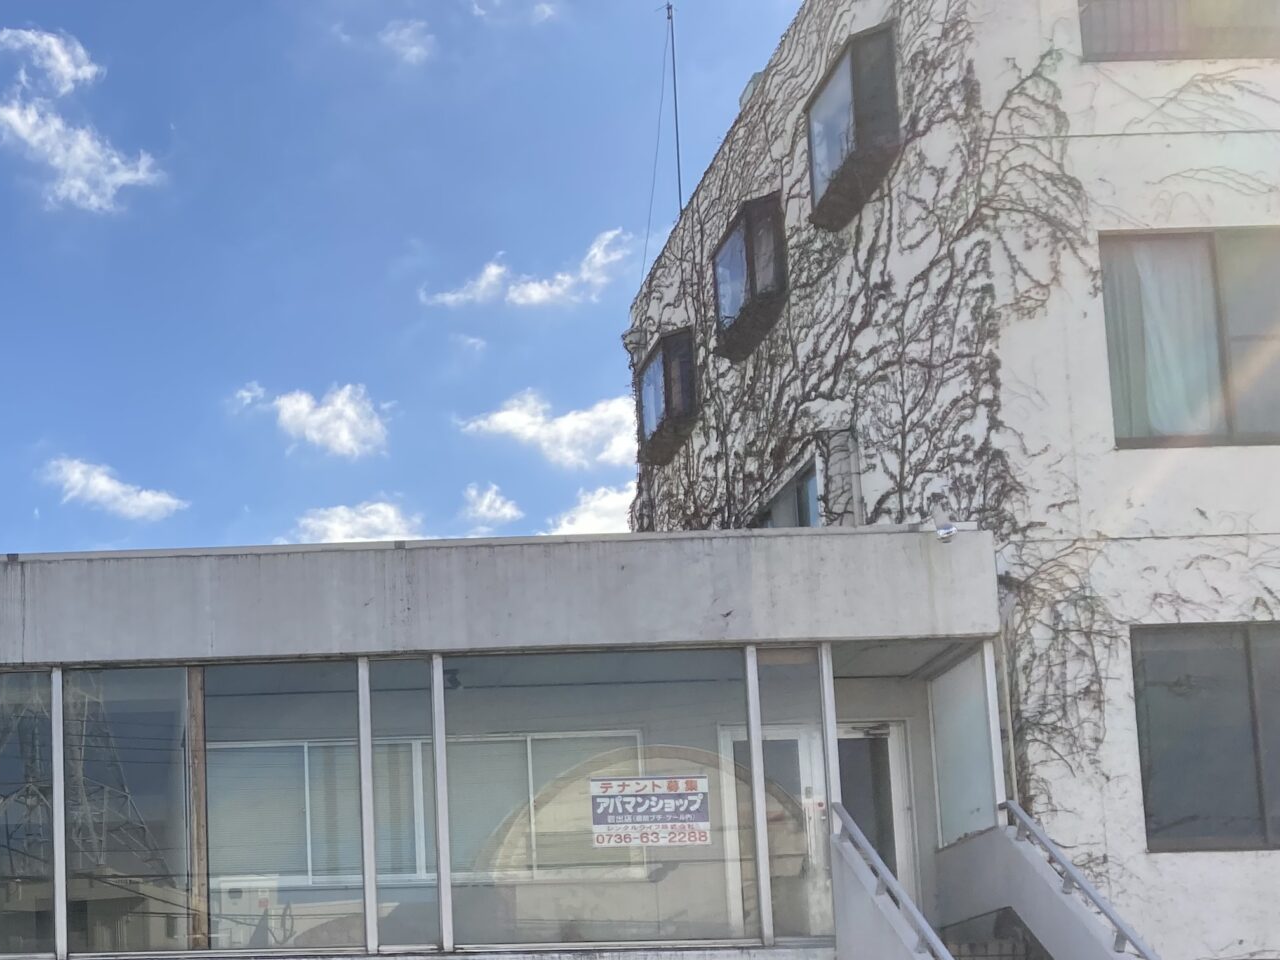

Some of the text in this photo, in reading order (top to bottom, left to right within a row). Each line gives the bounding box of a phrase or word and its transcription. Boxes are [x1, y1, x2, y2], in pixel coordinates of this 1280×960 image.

[600, 780, 698, 793] テナント募集
[596, 794, 704, 814] アパマンショップ
[596, 832, 708, 844] 0736-63-2288
